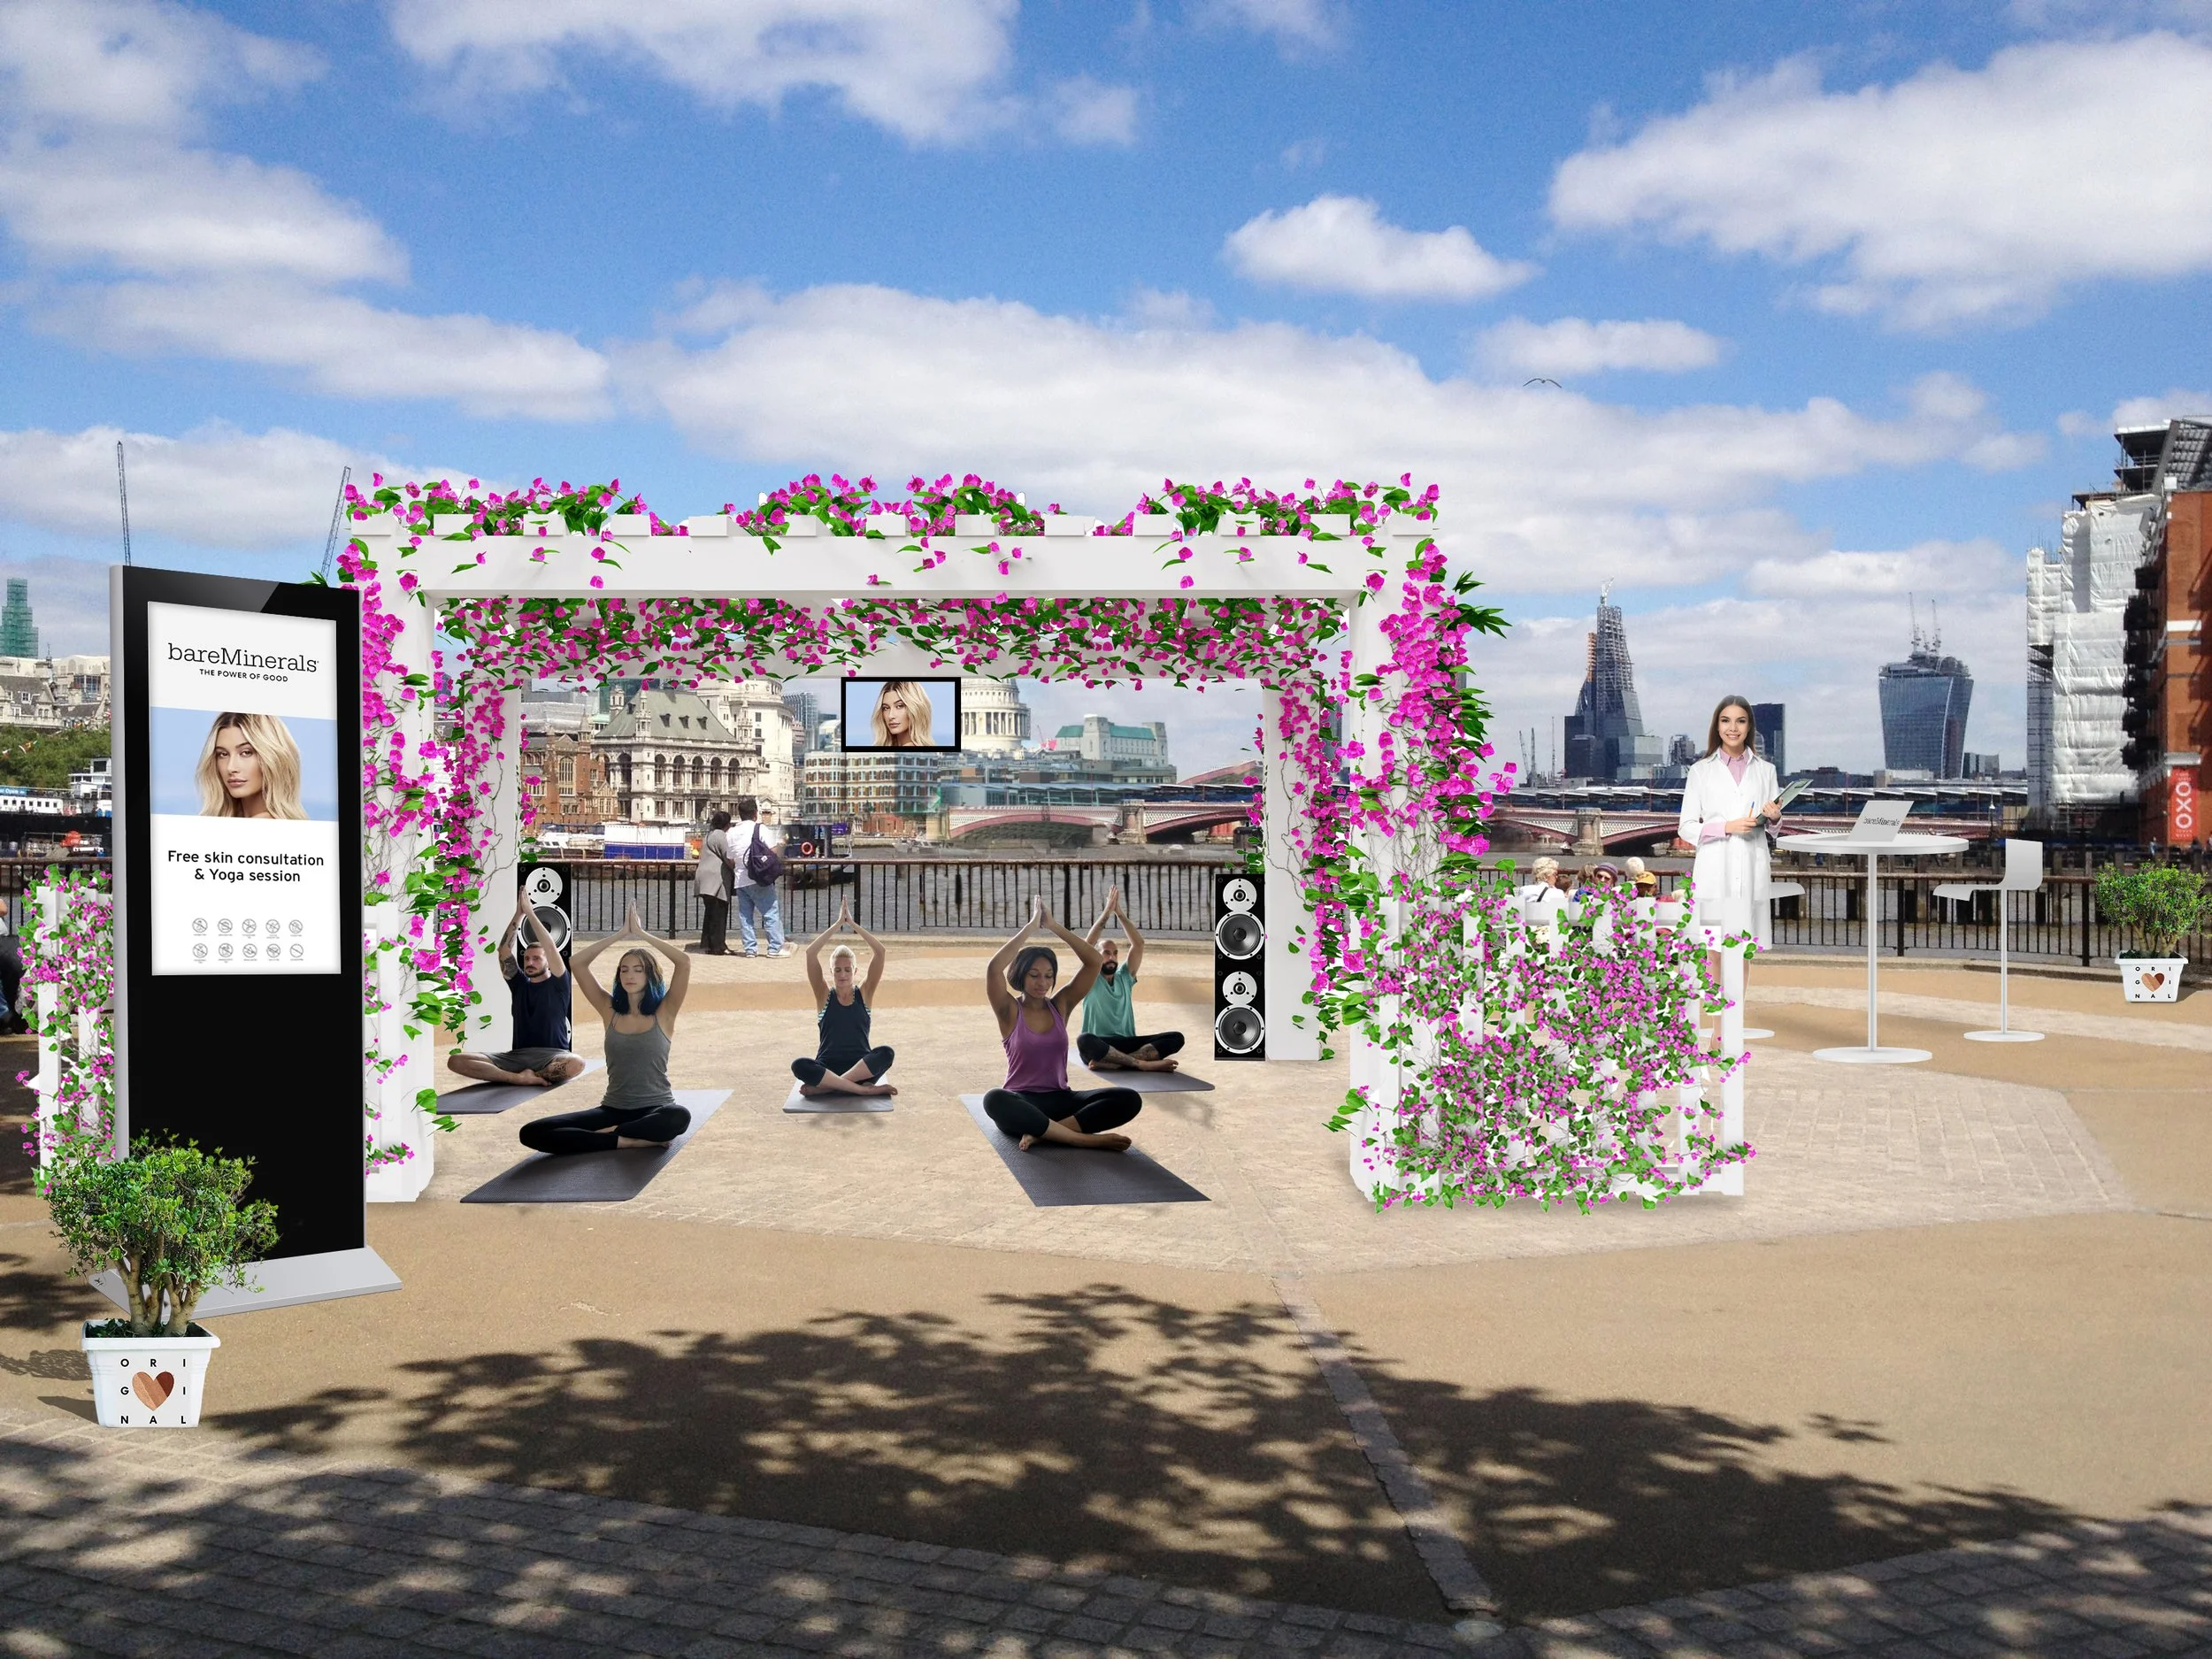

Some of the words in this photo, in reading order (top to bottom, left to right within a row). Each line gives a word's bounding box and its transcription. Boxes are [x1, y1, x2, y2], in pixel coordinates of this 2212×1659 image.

[168, 642, 317, 672] bareMinerals
[2176, 781, 2193, 829] OXO
[168, 849, 199, 862] Free
[204, 851, 233, 864] skin
[238, 854, 324, 866] consultation
[195, 868, 204, 880] &
[210, 869, 243, 883] Yoga
[250, 871, 300, 882] session
